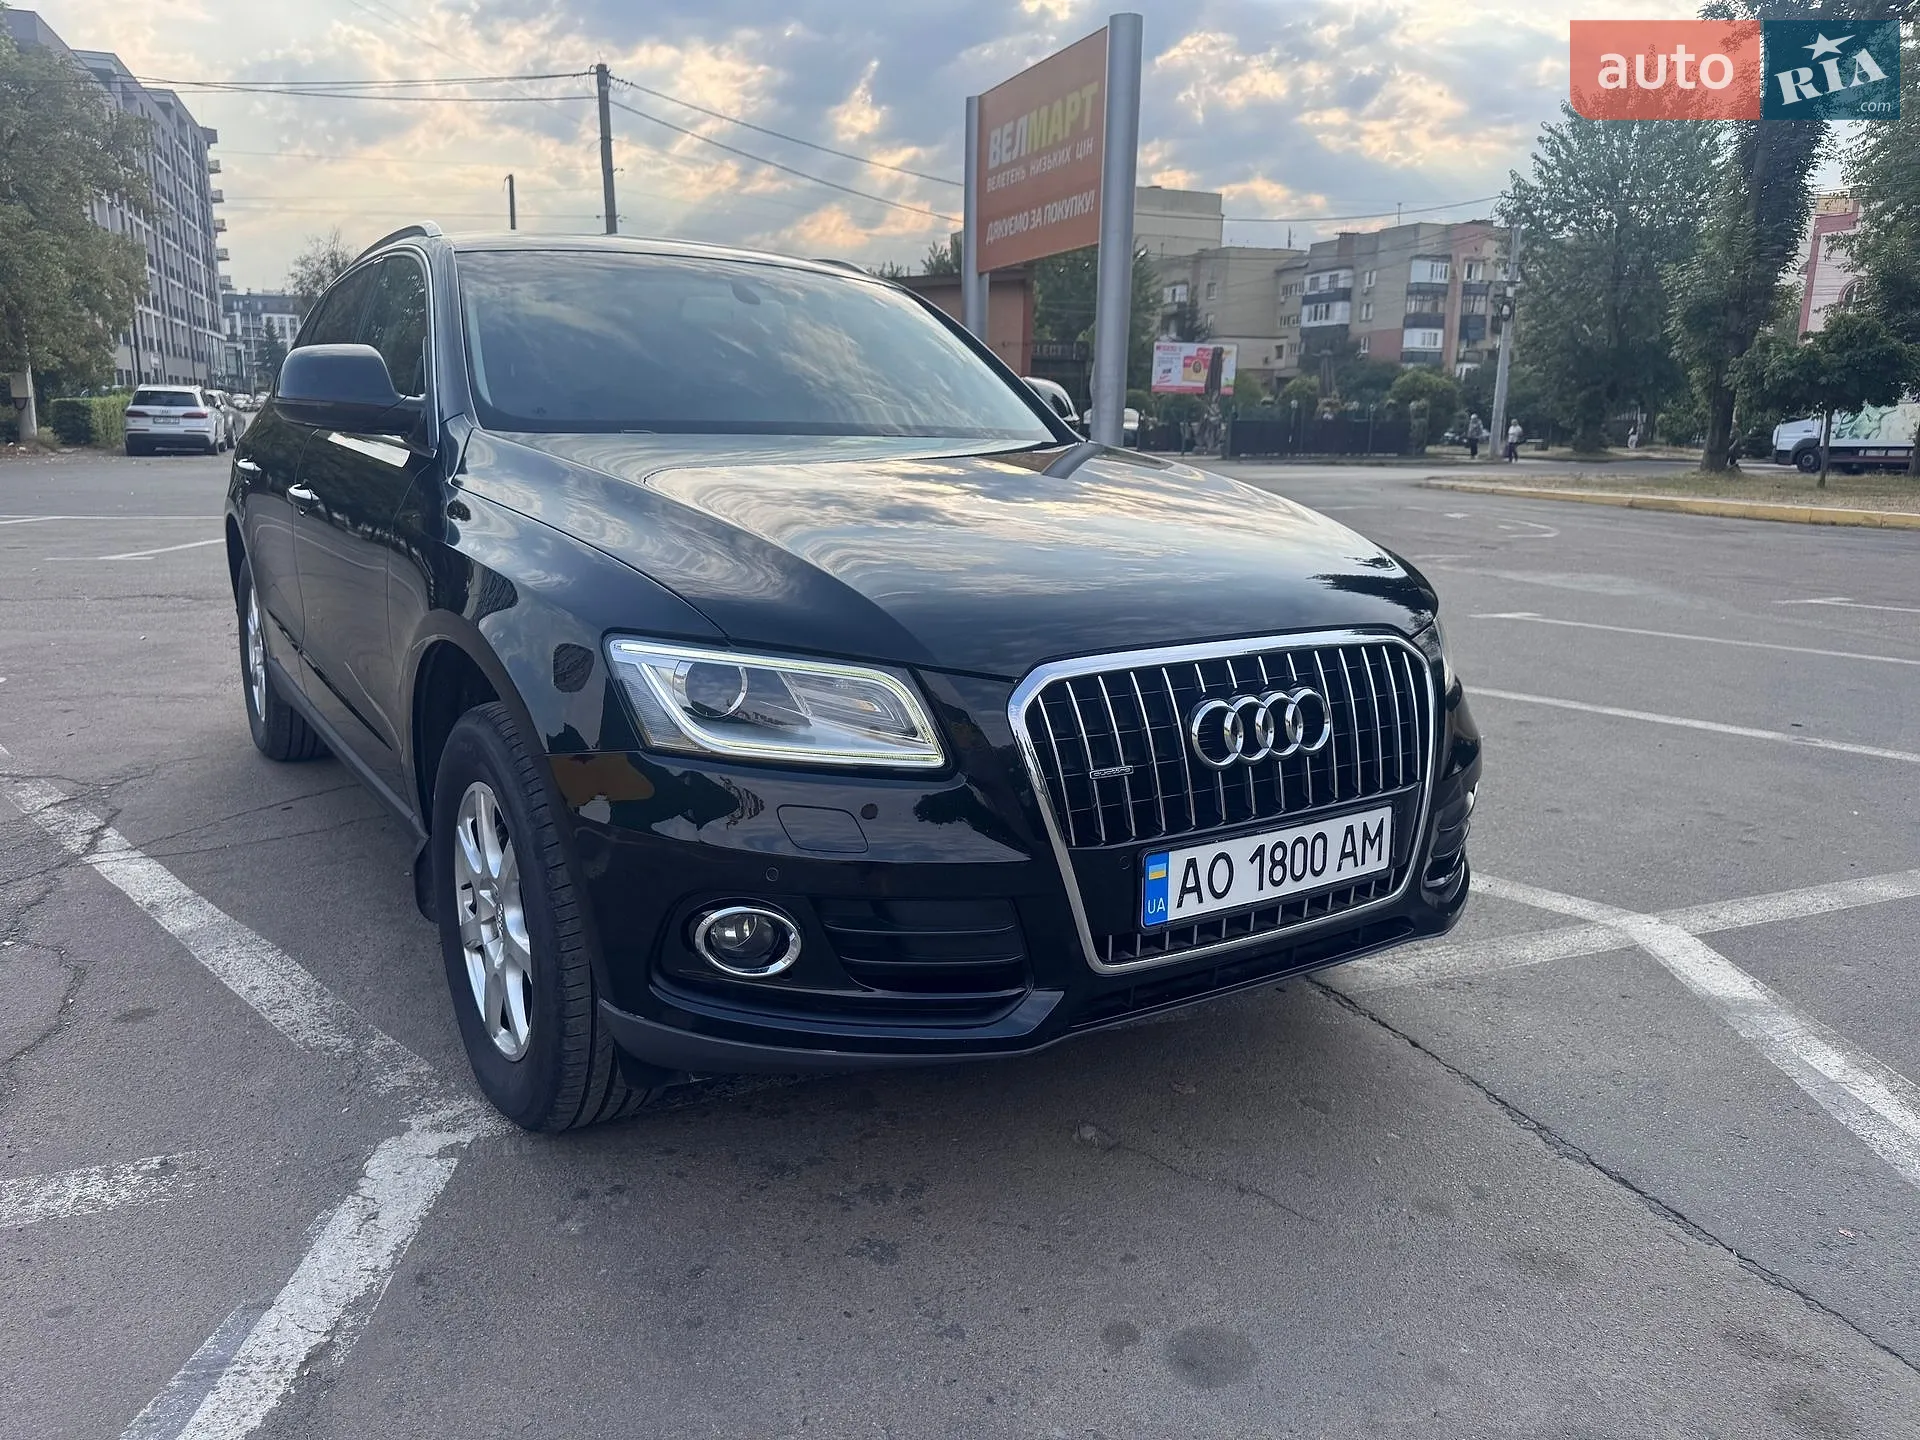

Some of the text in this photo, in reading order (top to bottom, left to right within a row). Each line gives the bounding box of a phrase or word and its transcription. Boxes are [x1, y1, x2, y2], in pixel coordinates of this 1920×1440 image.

[988, 82, 1098, 169] ВЕЛМАРТ
[986, 138, 1093, 193] ВЕЛЕТЕНЬ НИЗЬКИХ ЦІН
[1030, 207, 1043, 230] ЗА
[1043, 190, 1096, 225] ПОКУПКУ!
[1176, 816, 1385, 909] AO 1800 AM
[1147, 896, 1167, 914] UA
